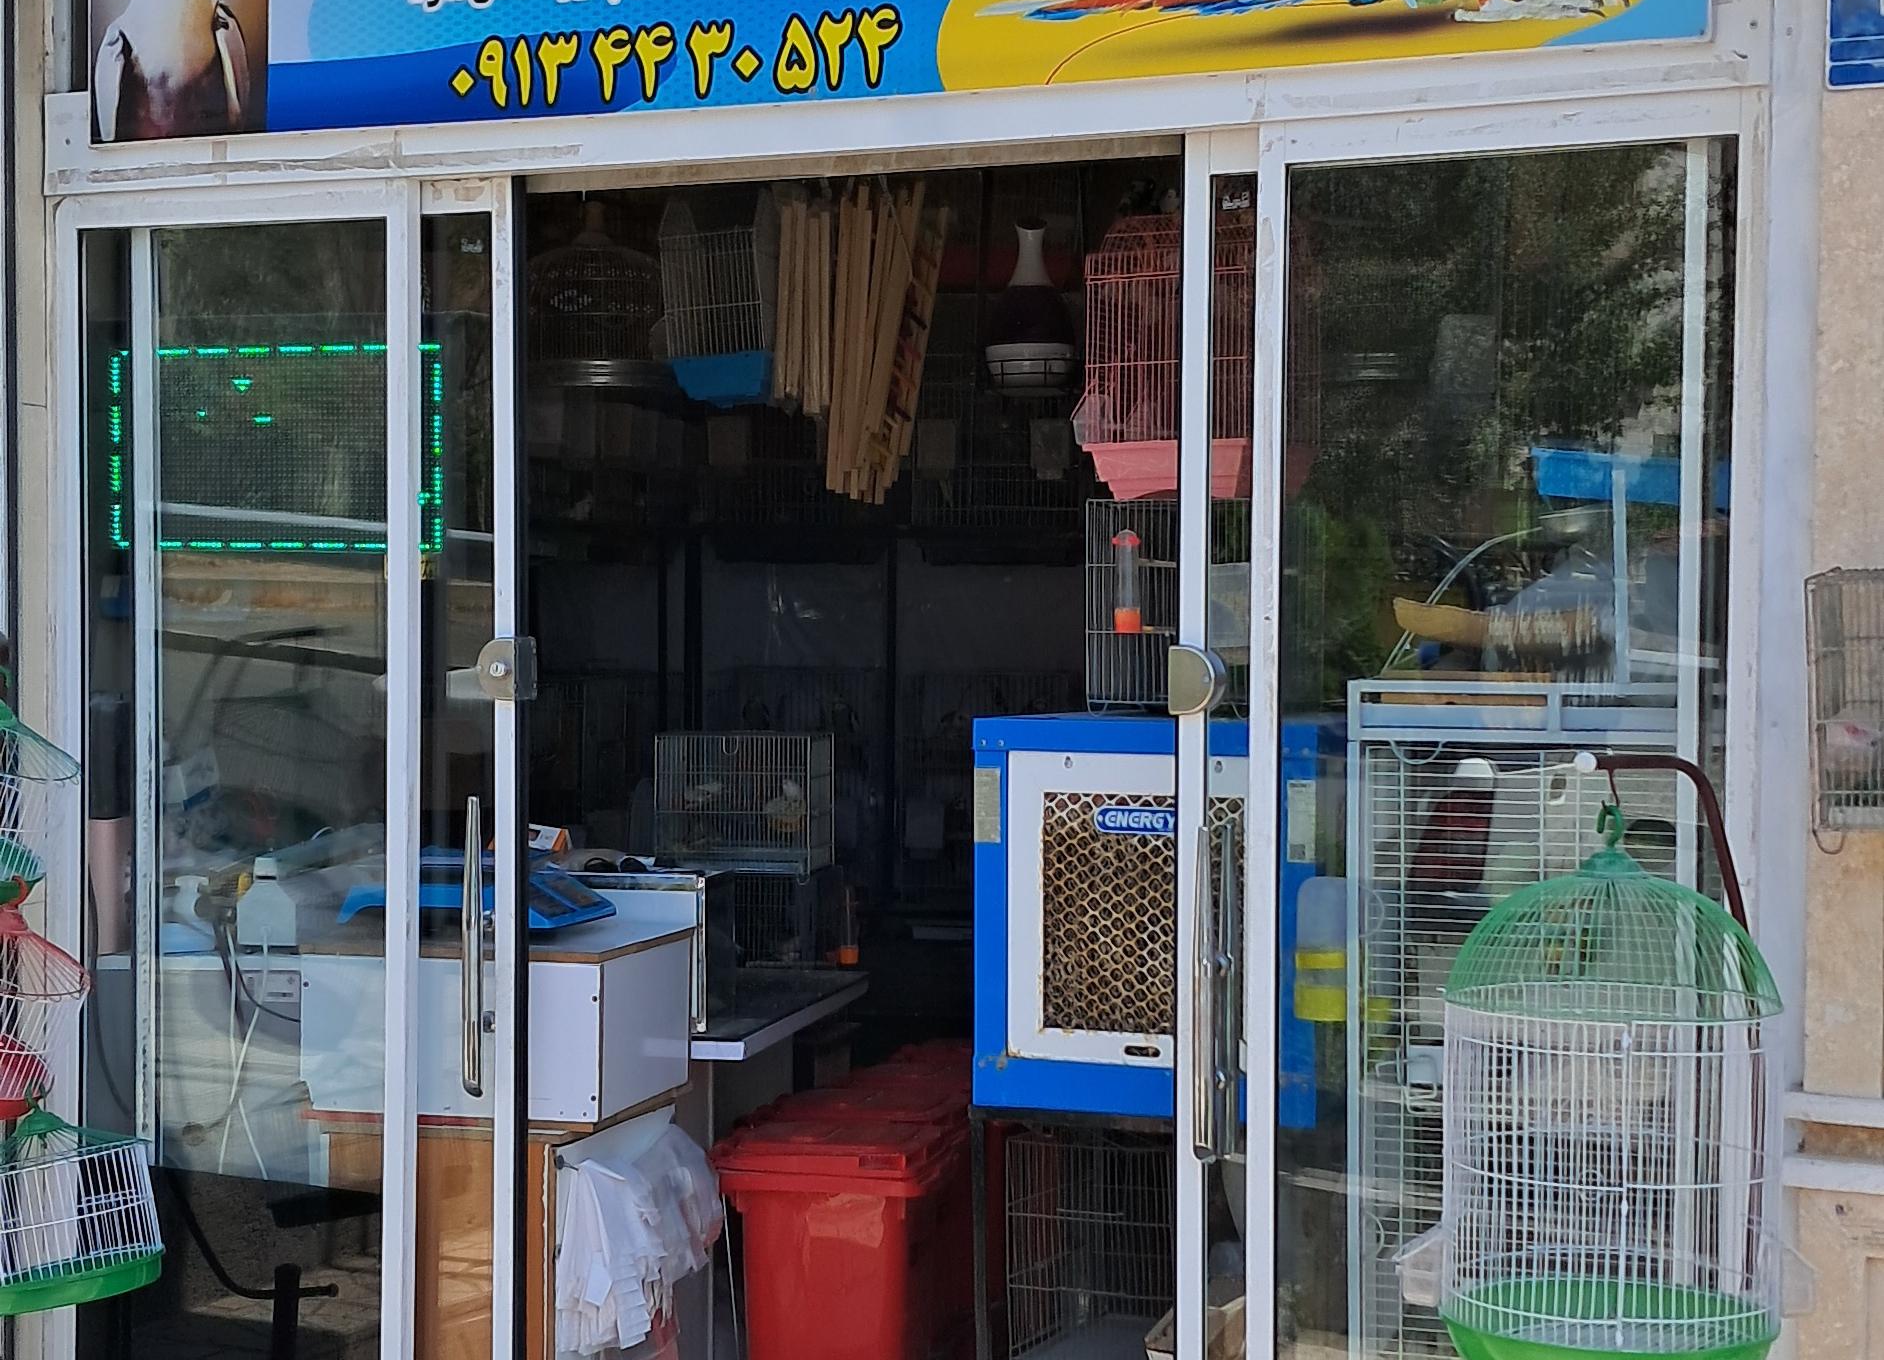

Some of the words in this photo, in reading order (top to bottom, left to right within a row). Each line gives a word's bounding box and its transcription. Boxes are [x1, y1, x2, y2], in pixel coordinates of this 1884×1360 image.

[450, 31, 580, 109] ۰۹۱۳
[591, 22, 676, 102] ۴۴
[687, 16, 764, 101] ۳۰
[773, 2, 902, 94] ۵۲۴
